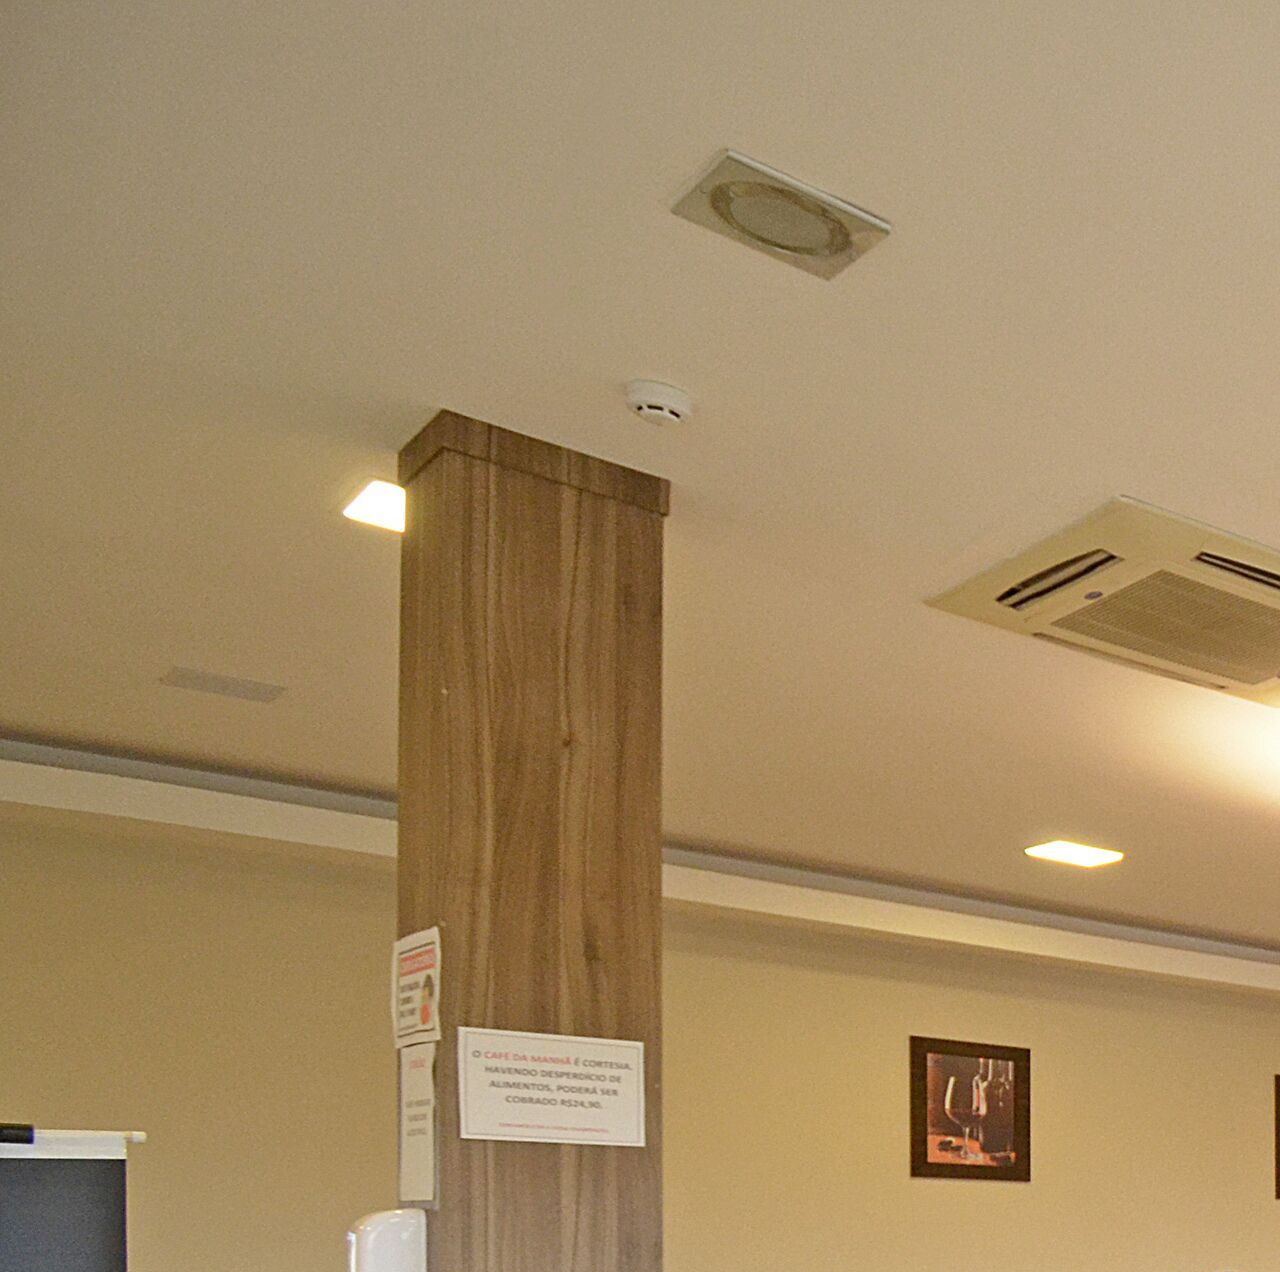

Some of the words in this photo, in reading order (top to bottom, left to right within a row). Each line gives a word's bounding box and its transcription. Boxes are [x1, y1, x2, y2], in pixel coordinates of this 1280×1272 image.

[484, 1051, 510, 1061] CAFÉ
[513, 1053, 529, 1062] DA
[531, 1054, 572, 1065] MANHÃ
[484, 1066, 538, 1077] HAVENDO
[609, 1074, 622, 1083] DE
[557, 1084, 598, 1096] PODERÁ
[601, 1087, 619, 1097] SER
[505, 1095, 557, 1106] COBRADO
